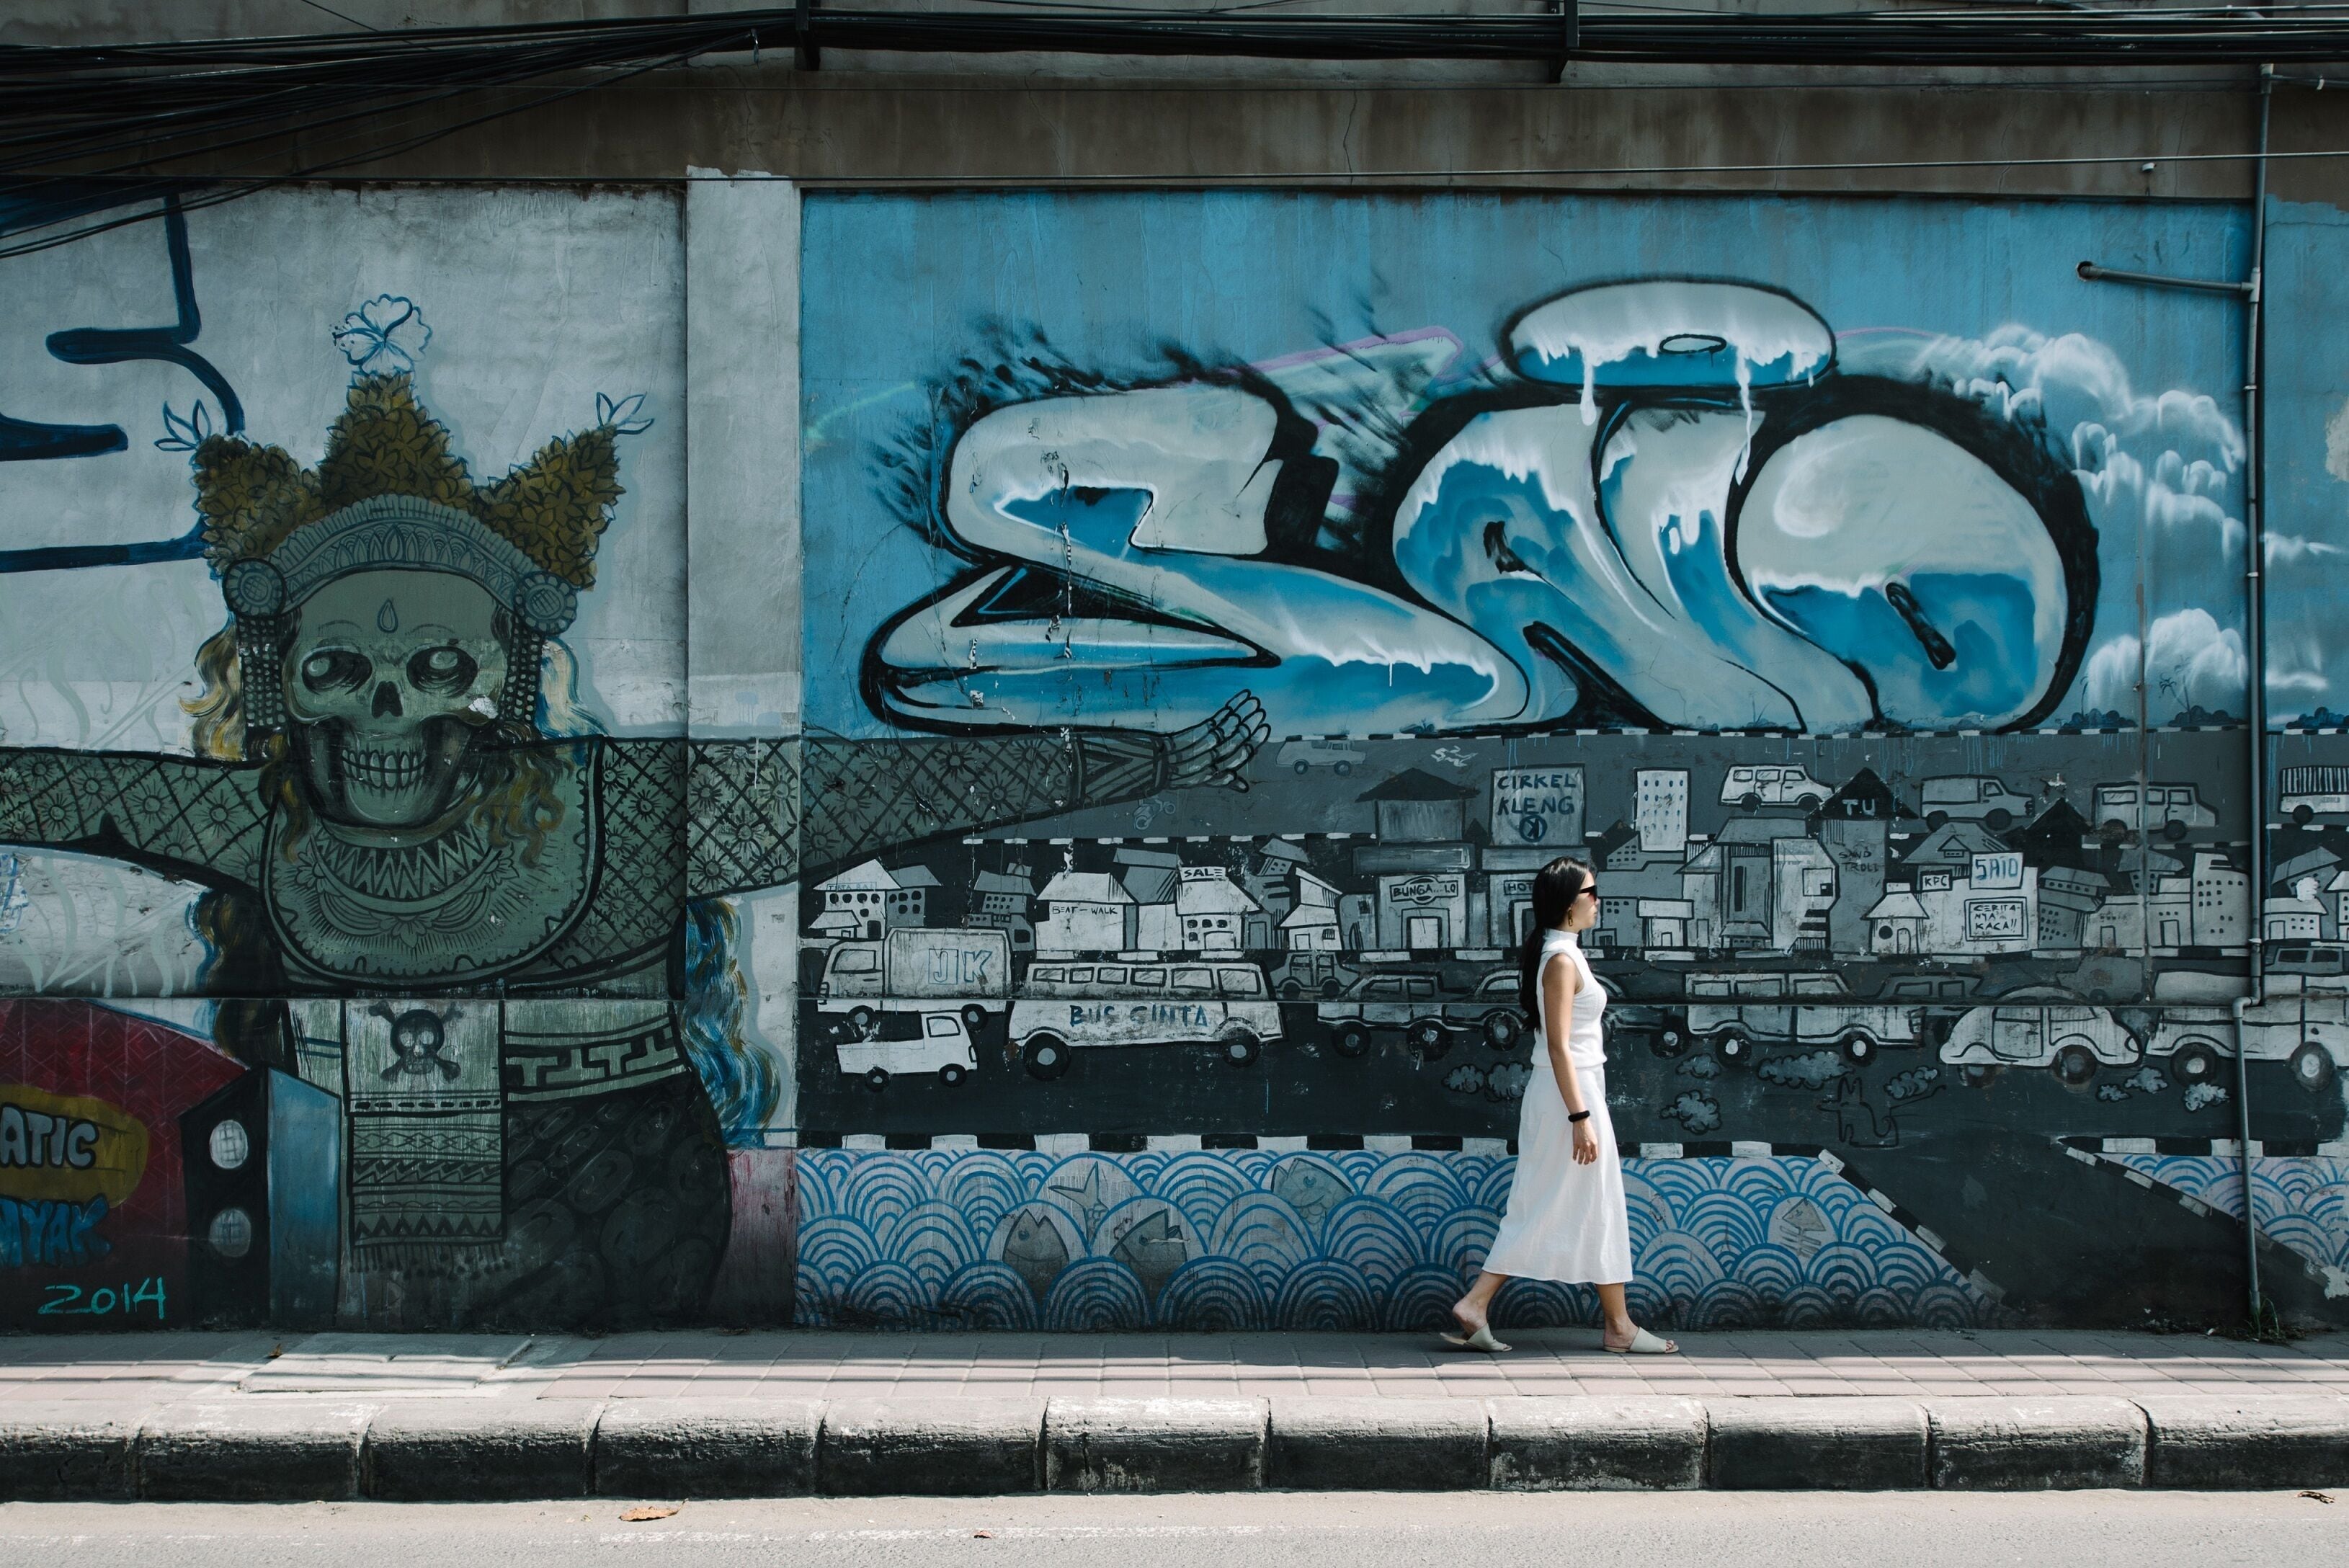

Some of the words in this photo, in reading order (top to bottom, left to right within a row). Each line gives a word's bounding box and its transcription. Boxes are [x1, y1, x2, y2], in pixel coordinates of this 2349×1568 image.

[1497, 773, 1576, 790] CIRKEL
[1497, 796, 1575, 815] KLENG
[1842, 798, 1876, 816] TU
[1184, 868, 1223, 877] SALE
[1052, 906, 1077, 914] BEAT
[1975, 919, 2017, 932] KACA!!
[37, 1277, 167, 1319] 2014
